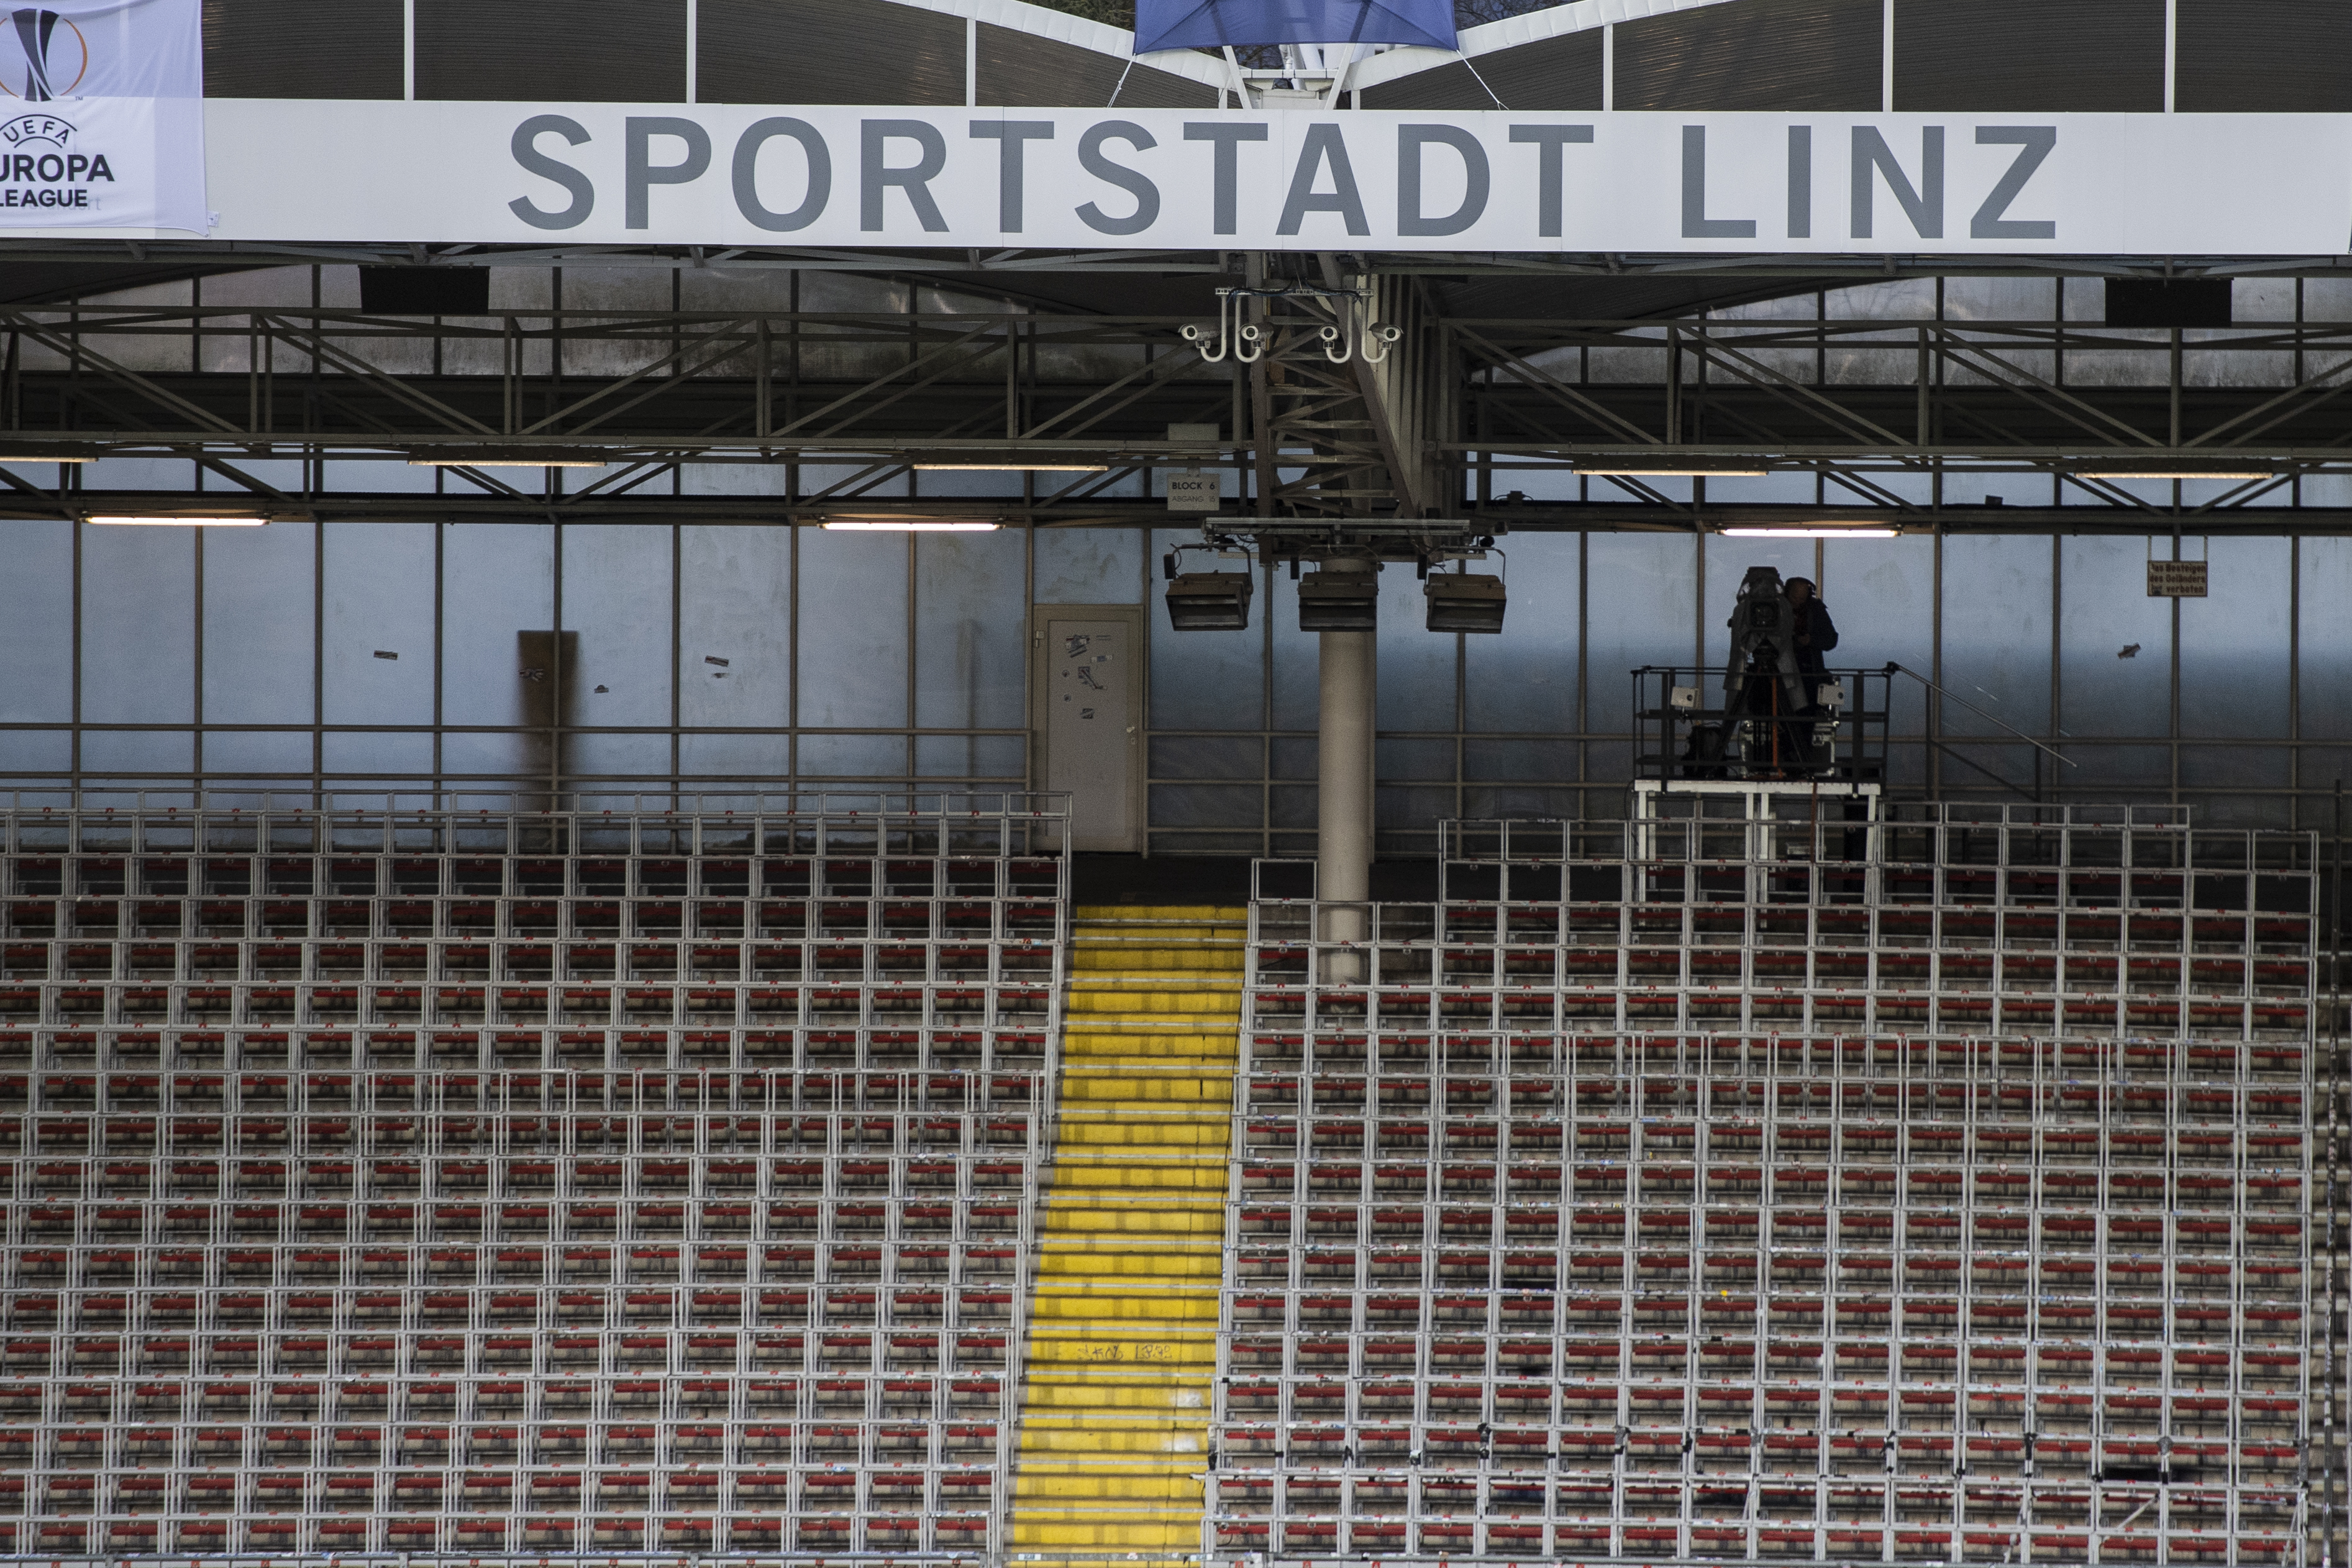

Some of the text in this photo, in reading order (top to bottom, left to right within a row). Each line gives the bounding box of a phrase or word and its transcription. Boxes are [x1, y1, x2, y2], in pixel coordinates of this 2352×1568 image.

[2, 119, 70, 144] UEFA
[0, 153, 115, 183] UROPA
[508, 114, 2057, 239] SPORTSTADT LINZ
[0, 189, 88, 207] EAGUE
[1172, 481, 1216, 490] BLOCK 6
[2166, 563, 2206, 575] Besteigen
[2149, 574, 2163, 583] des
[2166, 585, 2204, 593] verboten
